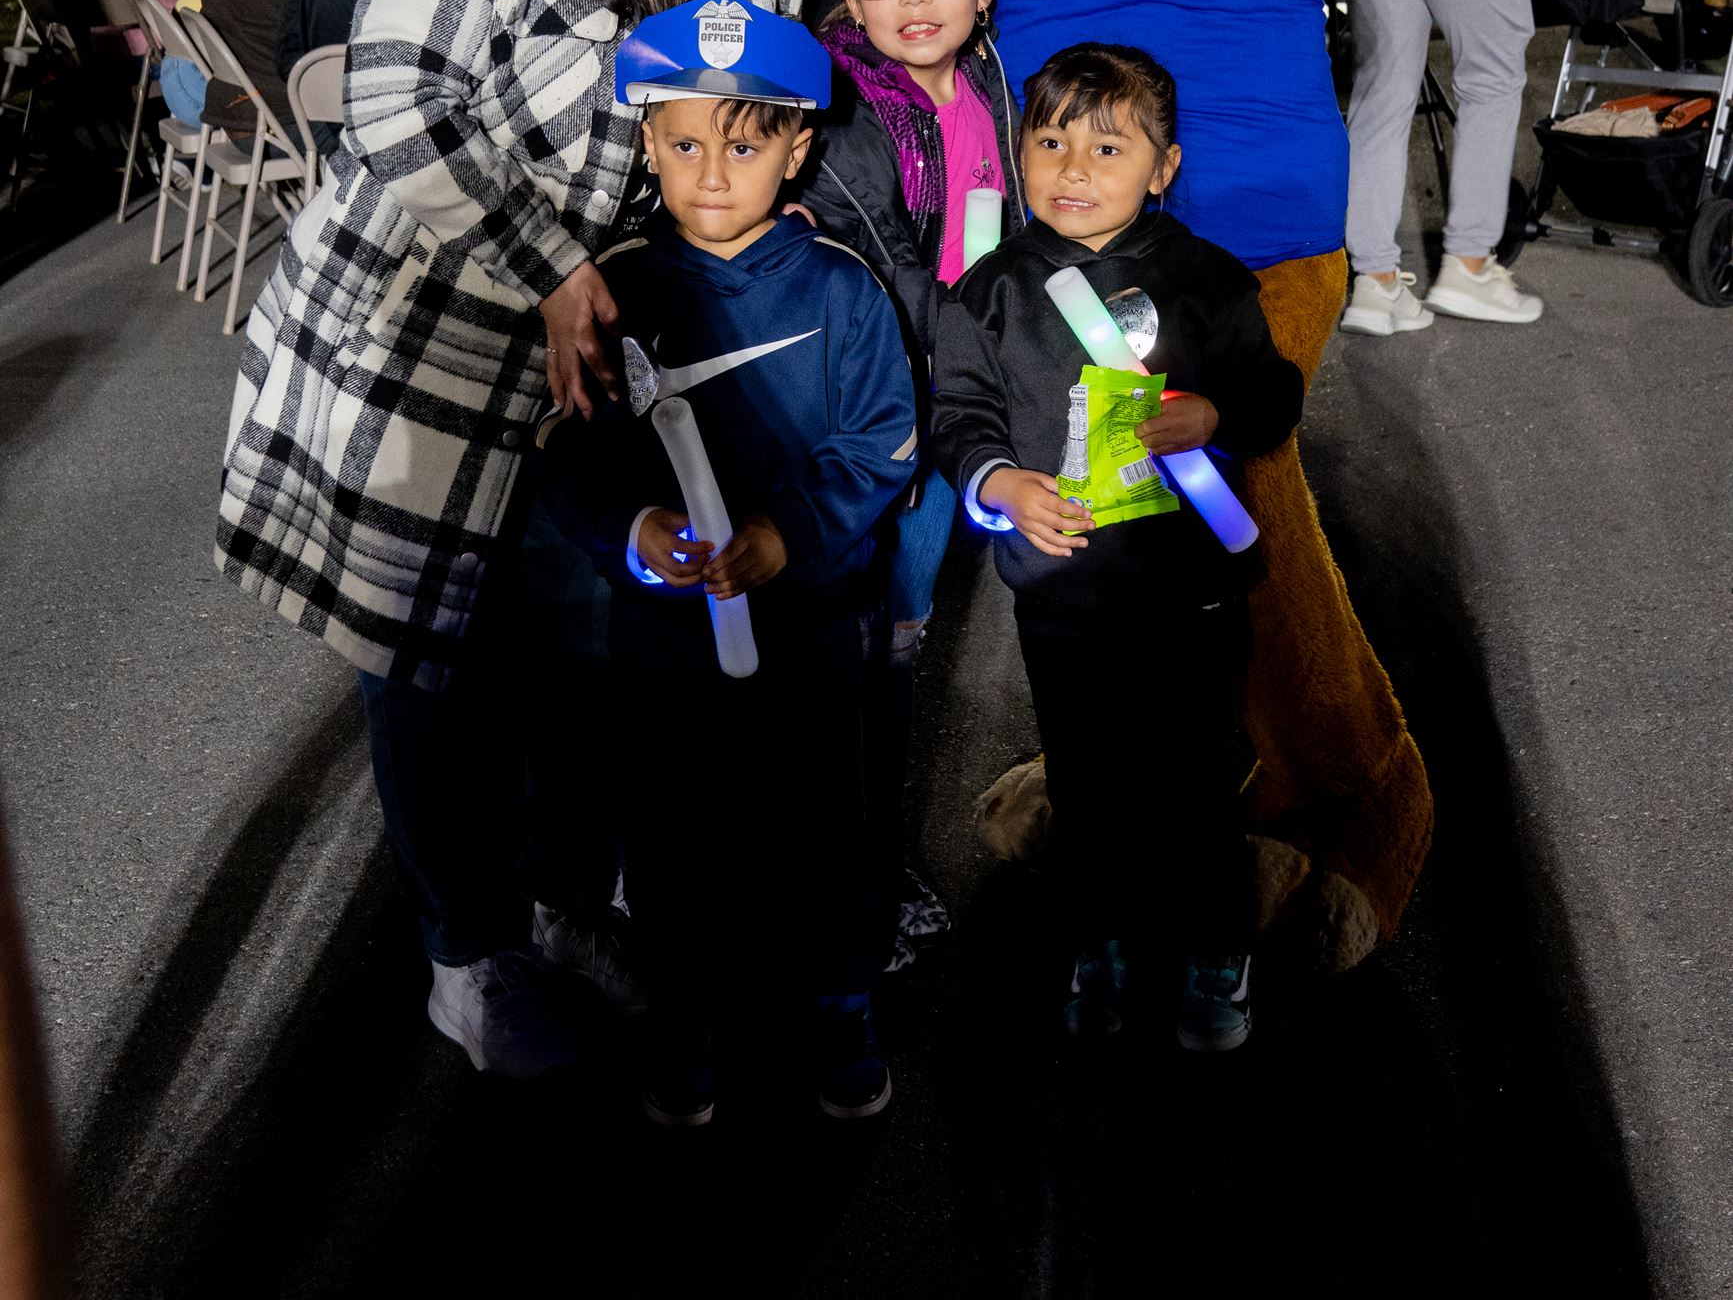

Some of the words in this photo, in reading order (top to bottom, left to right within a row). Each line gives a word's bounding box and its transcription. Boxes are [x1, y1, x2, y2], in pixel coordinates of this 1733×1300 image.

[704, 22, 741, 32] POLICE
[700, 32, 744, 43] OFFICER
[625, 360, 648, 372] ONTANA
[632, 396, 642, 404] 911
